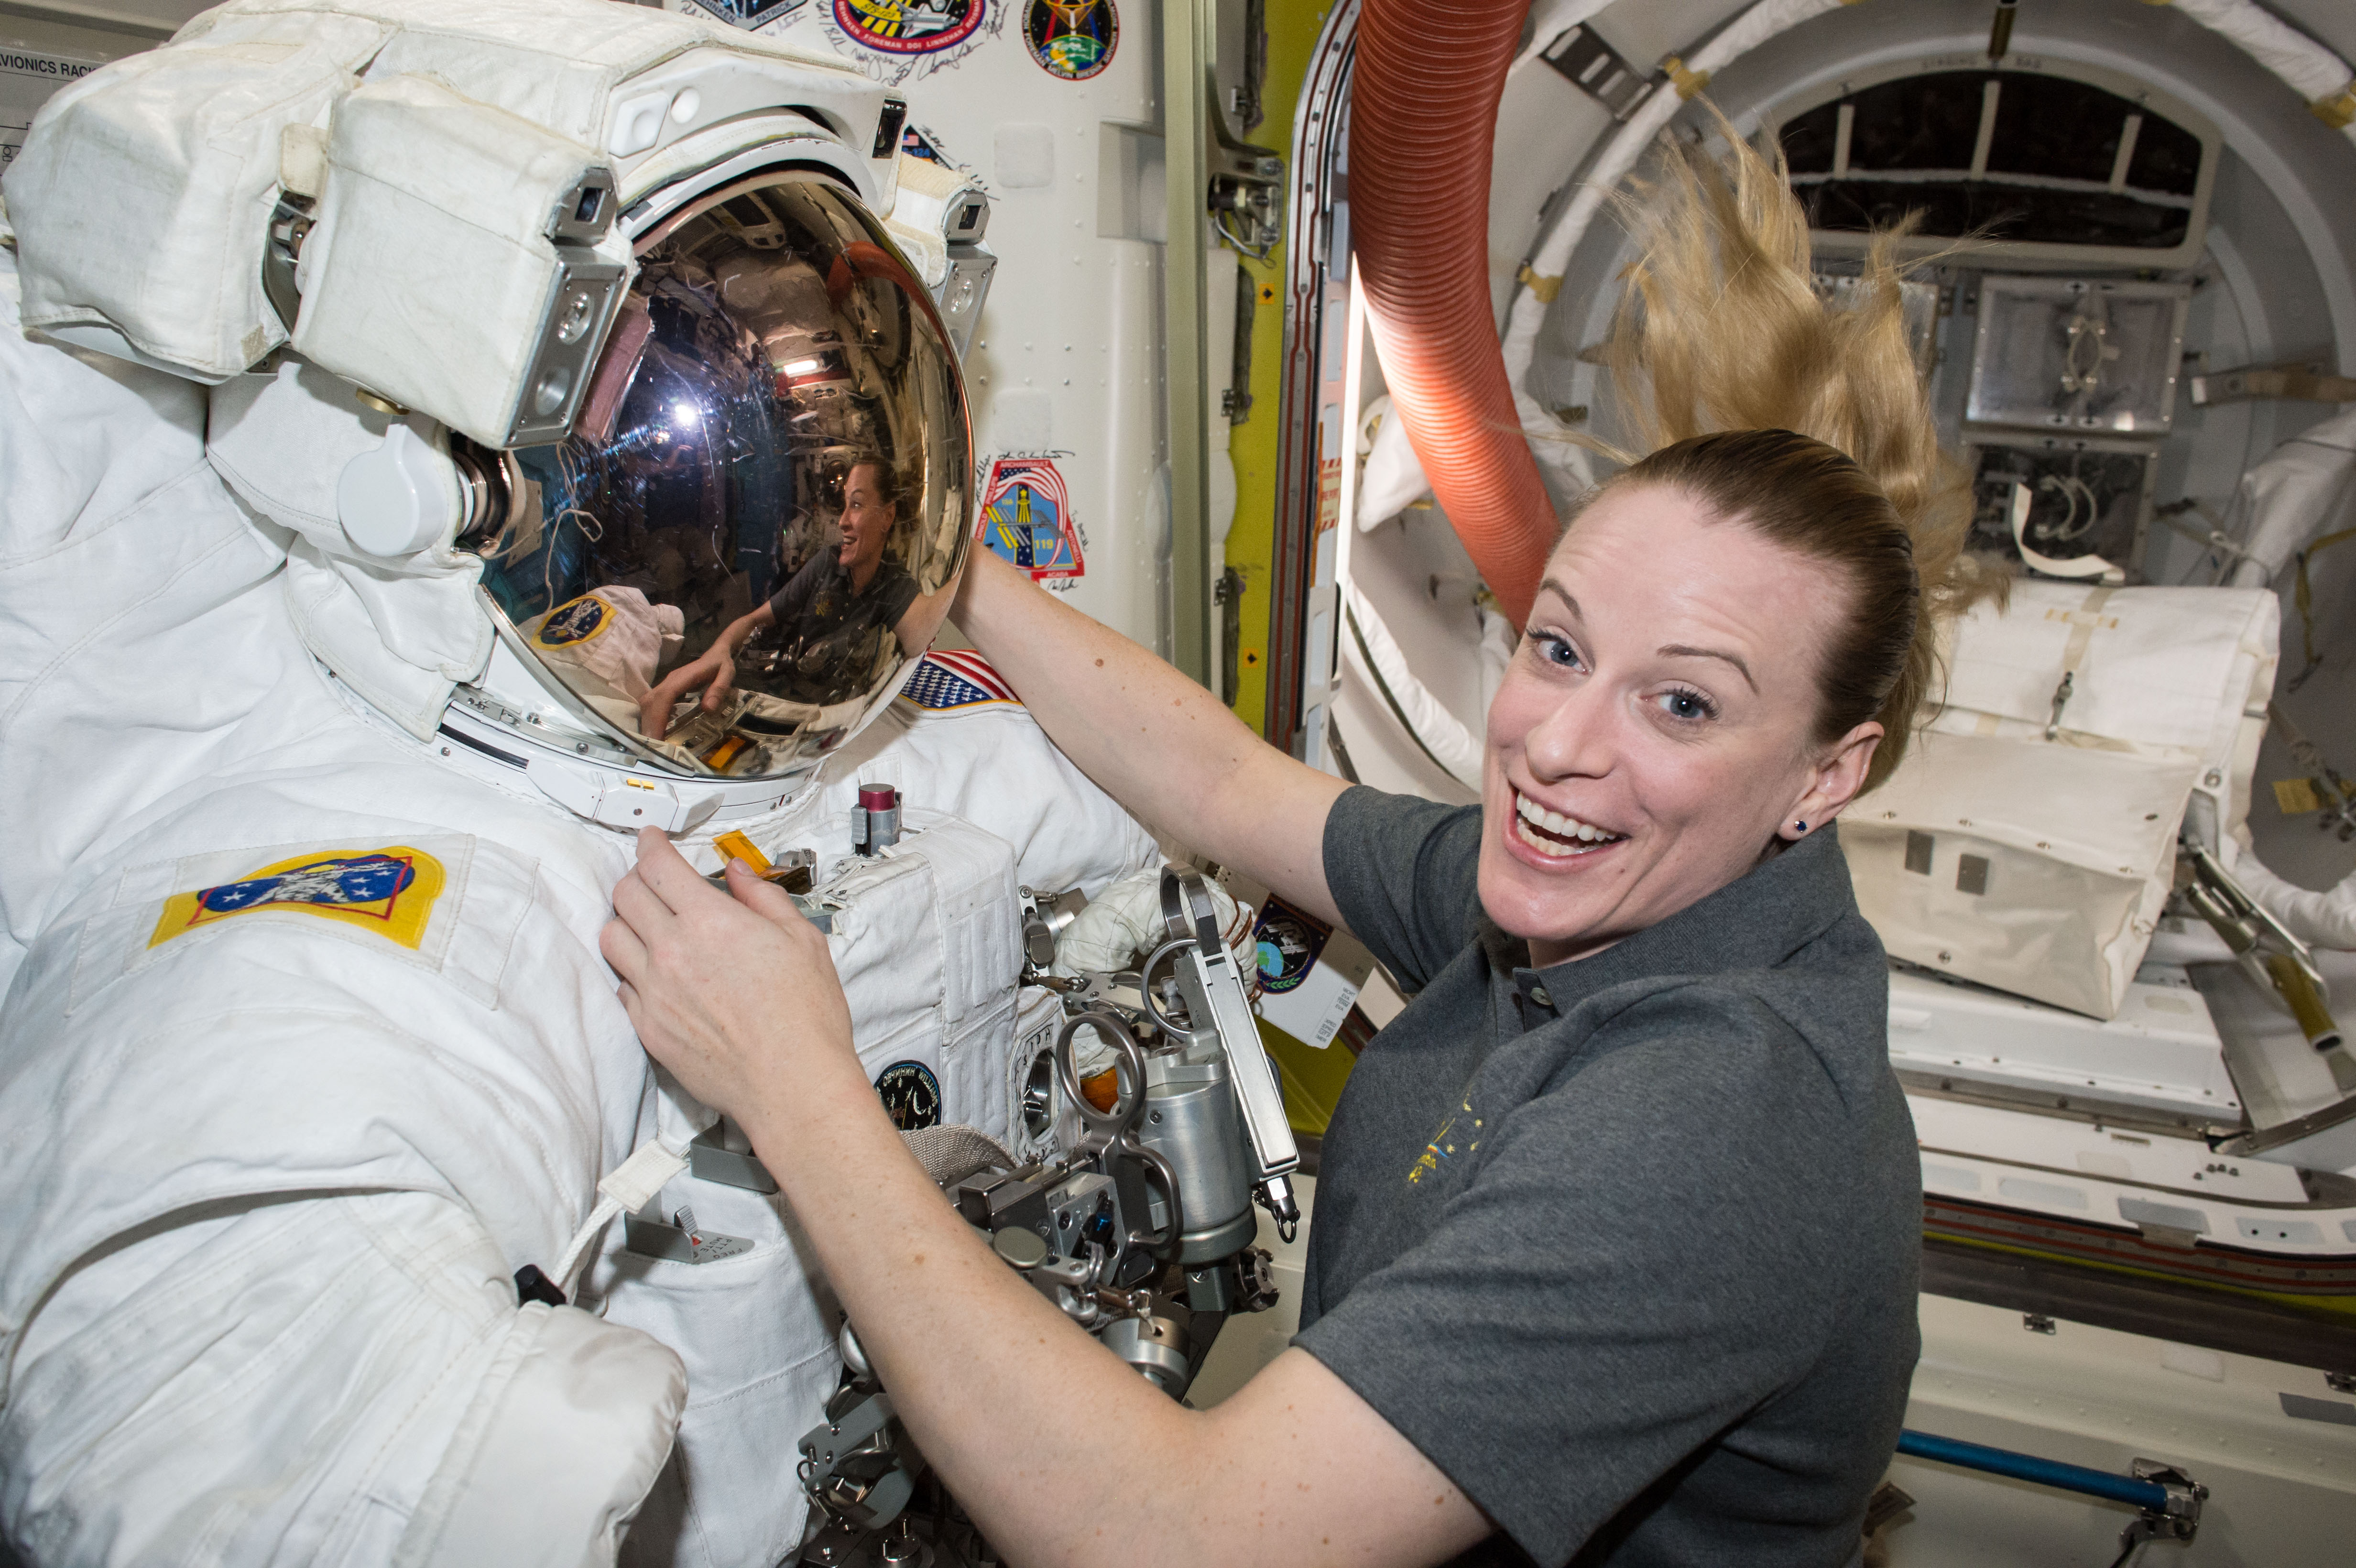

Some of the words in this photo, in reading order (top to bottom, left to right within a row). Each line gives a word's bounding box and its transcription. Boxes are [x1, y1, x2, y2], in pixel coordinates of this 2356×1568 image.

[700, 0, 735, 22] HNKEN
[756, 0, 792, 23] PATRICK
[838, 1, 860, 35] BEHNKEN
[864, 33, 902, 48] FOREMAN
[926, 28, 964, 47] LINNEHAN
[965, 0, 980, 28] REISMA
[0, 54, 57, 74] VIONICS
[1034, 539, 1054, 550] 119
[700, 1237, 723, 1252] MUTE
[712, 1239, 732, 1253] PTT/
[713, 1248, 742, 1259] FREQ
